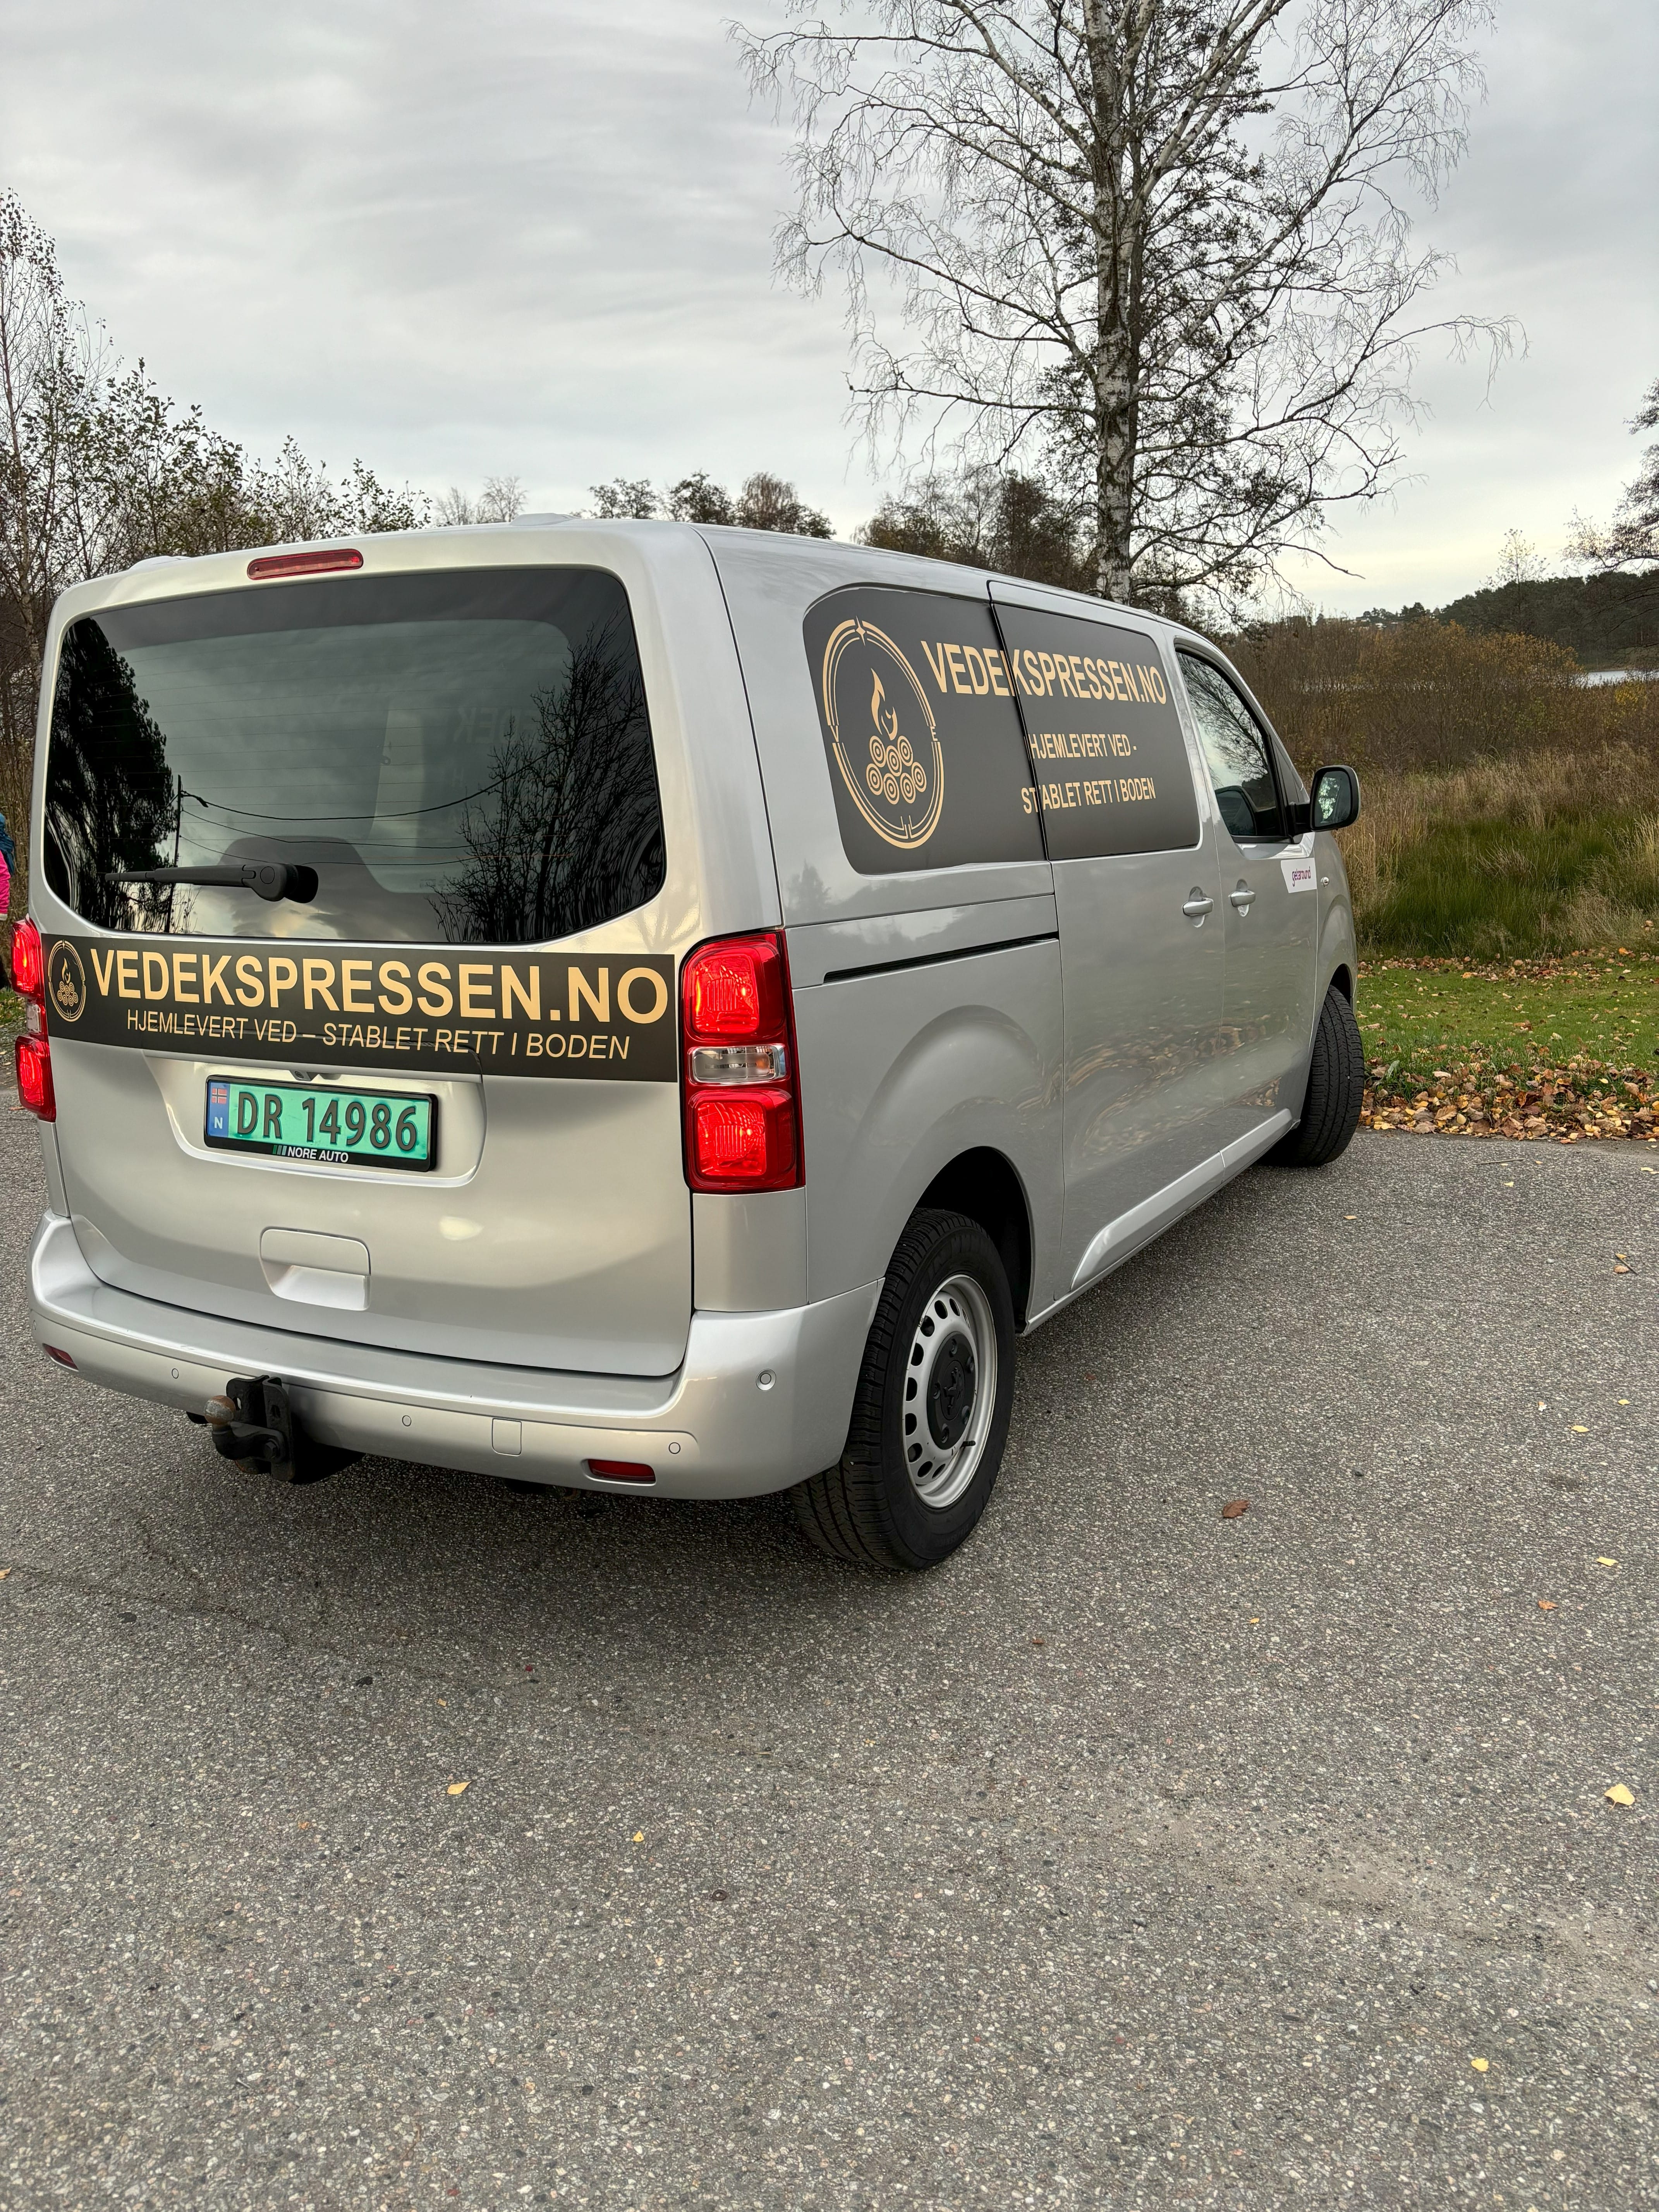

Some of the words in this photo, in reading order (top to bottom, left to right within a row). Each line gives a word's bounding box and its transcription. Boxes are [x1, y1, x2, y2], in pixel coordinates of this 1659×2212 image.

[921, 641, 1166, 704] VEDEKSPRESSEN.NO
[1028, 733, 1108, 759] HJEMLEVERT
[1108, 734, 1131, 756] VED
[1021, 782, 1082, 814] STABLET
[1083, 780, 1113, 805] RETT
[1113, 779, 1120, 802] I
[1119, 777, 1156, 802] BODEN
[1292, 866, 1311, 887] getaround
[90, 948, 668, 1024] VEDEKSPRESSEN.NO
[127, 1009, 249, 1039] HJEMLEVERT
[254, 1019, 297, 1043] VED
[323, 1022, 428, 1051] STABLET
[434, 1029, 505, 1054] RETT
[511, 1032, 517, 1056] I
[526, 1033, 630, 1060] BODEN
[214, 1116, 223, 1130] N
[237, 1092, 283, 1139] DR
[302, 1097, 417, 1151] 14986
[287, 1146, 316, 1160] NORE
[318, 1149, 349, 1163] AUTO
